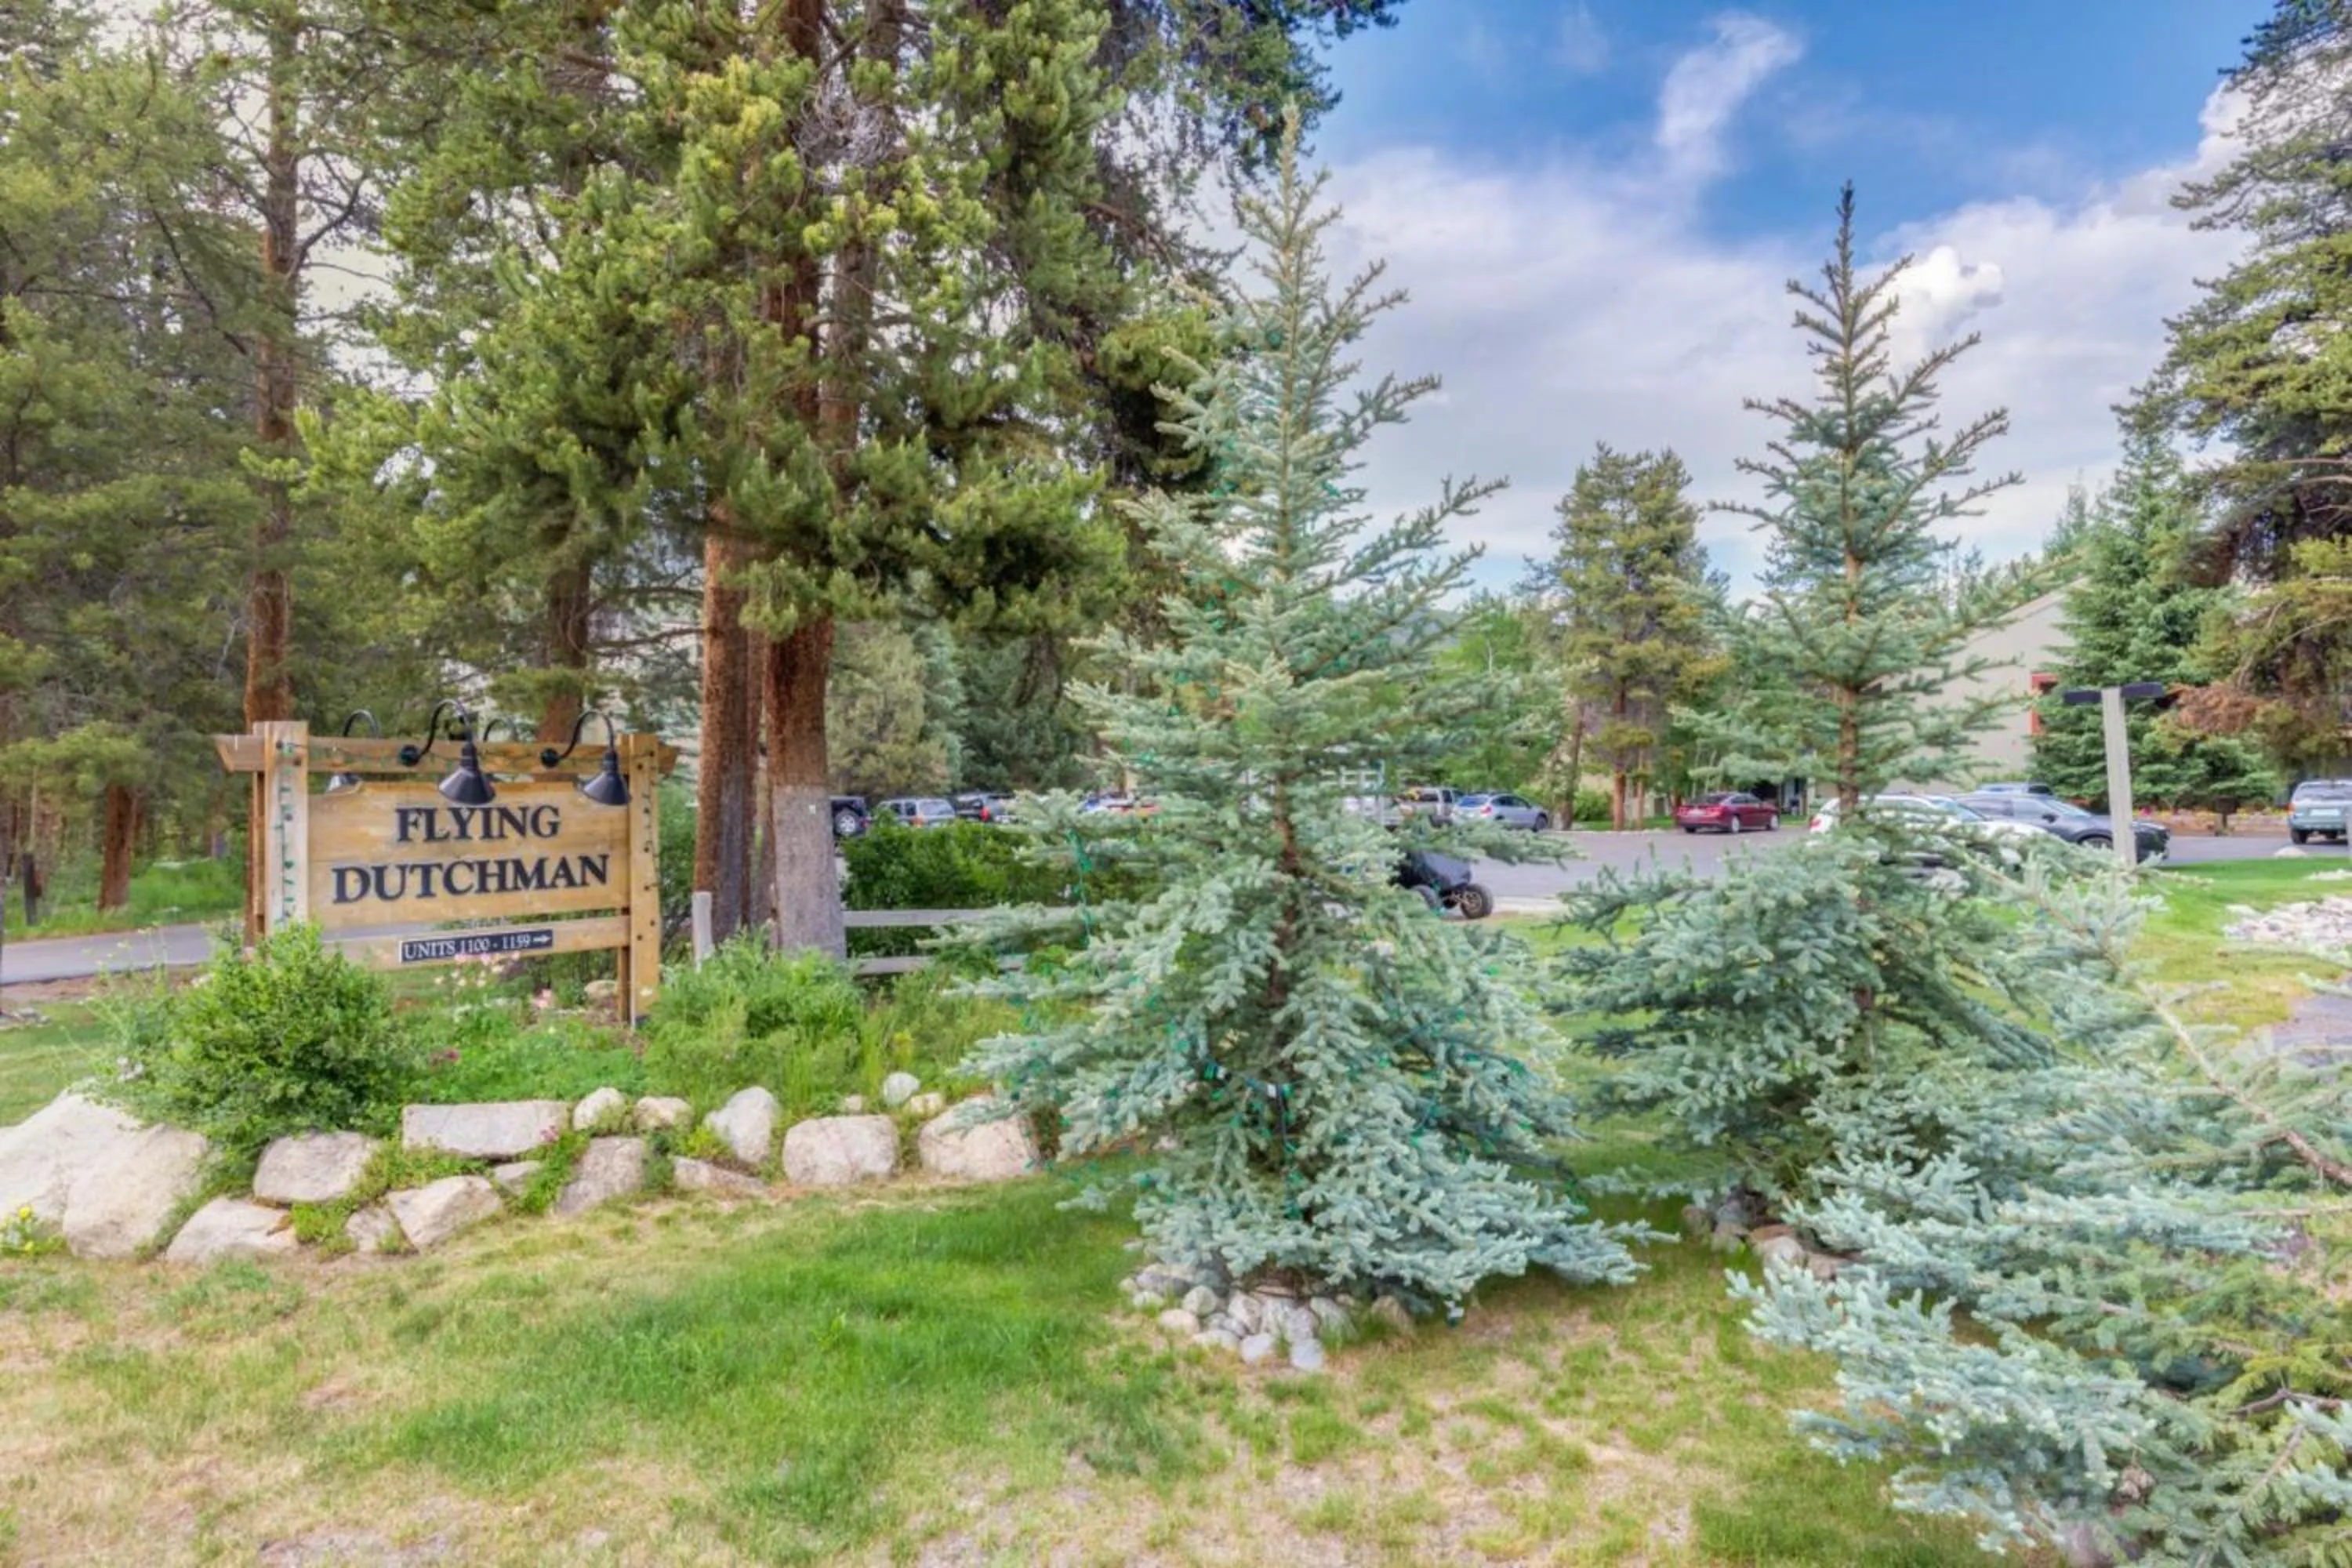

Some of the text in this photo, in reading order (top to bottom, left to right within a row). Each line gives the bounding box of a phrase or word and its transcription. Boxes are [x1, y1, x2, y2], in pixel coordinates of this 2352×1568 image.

[396, 804, 561, 842] FLYING
[332, 853, 609, 904] DUTCHMAN
[404, 941, 456, 960] UNITS
[457, 938, 490, 954] 1100
